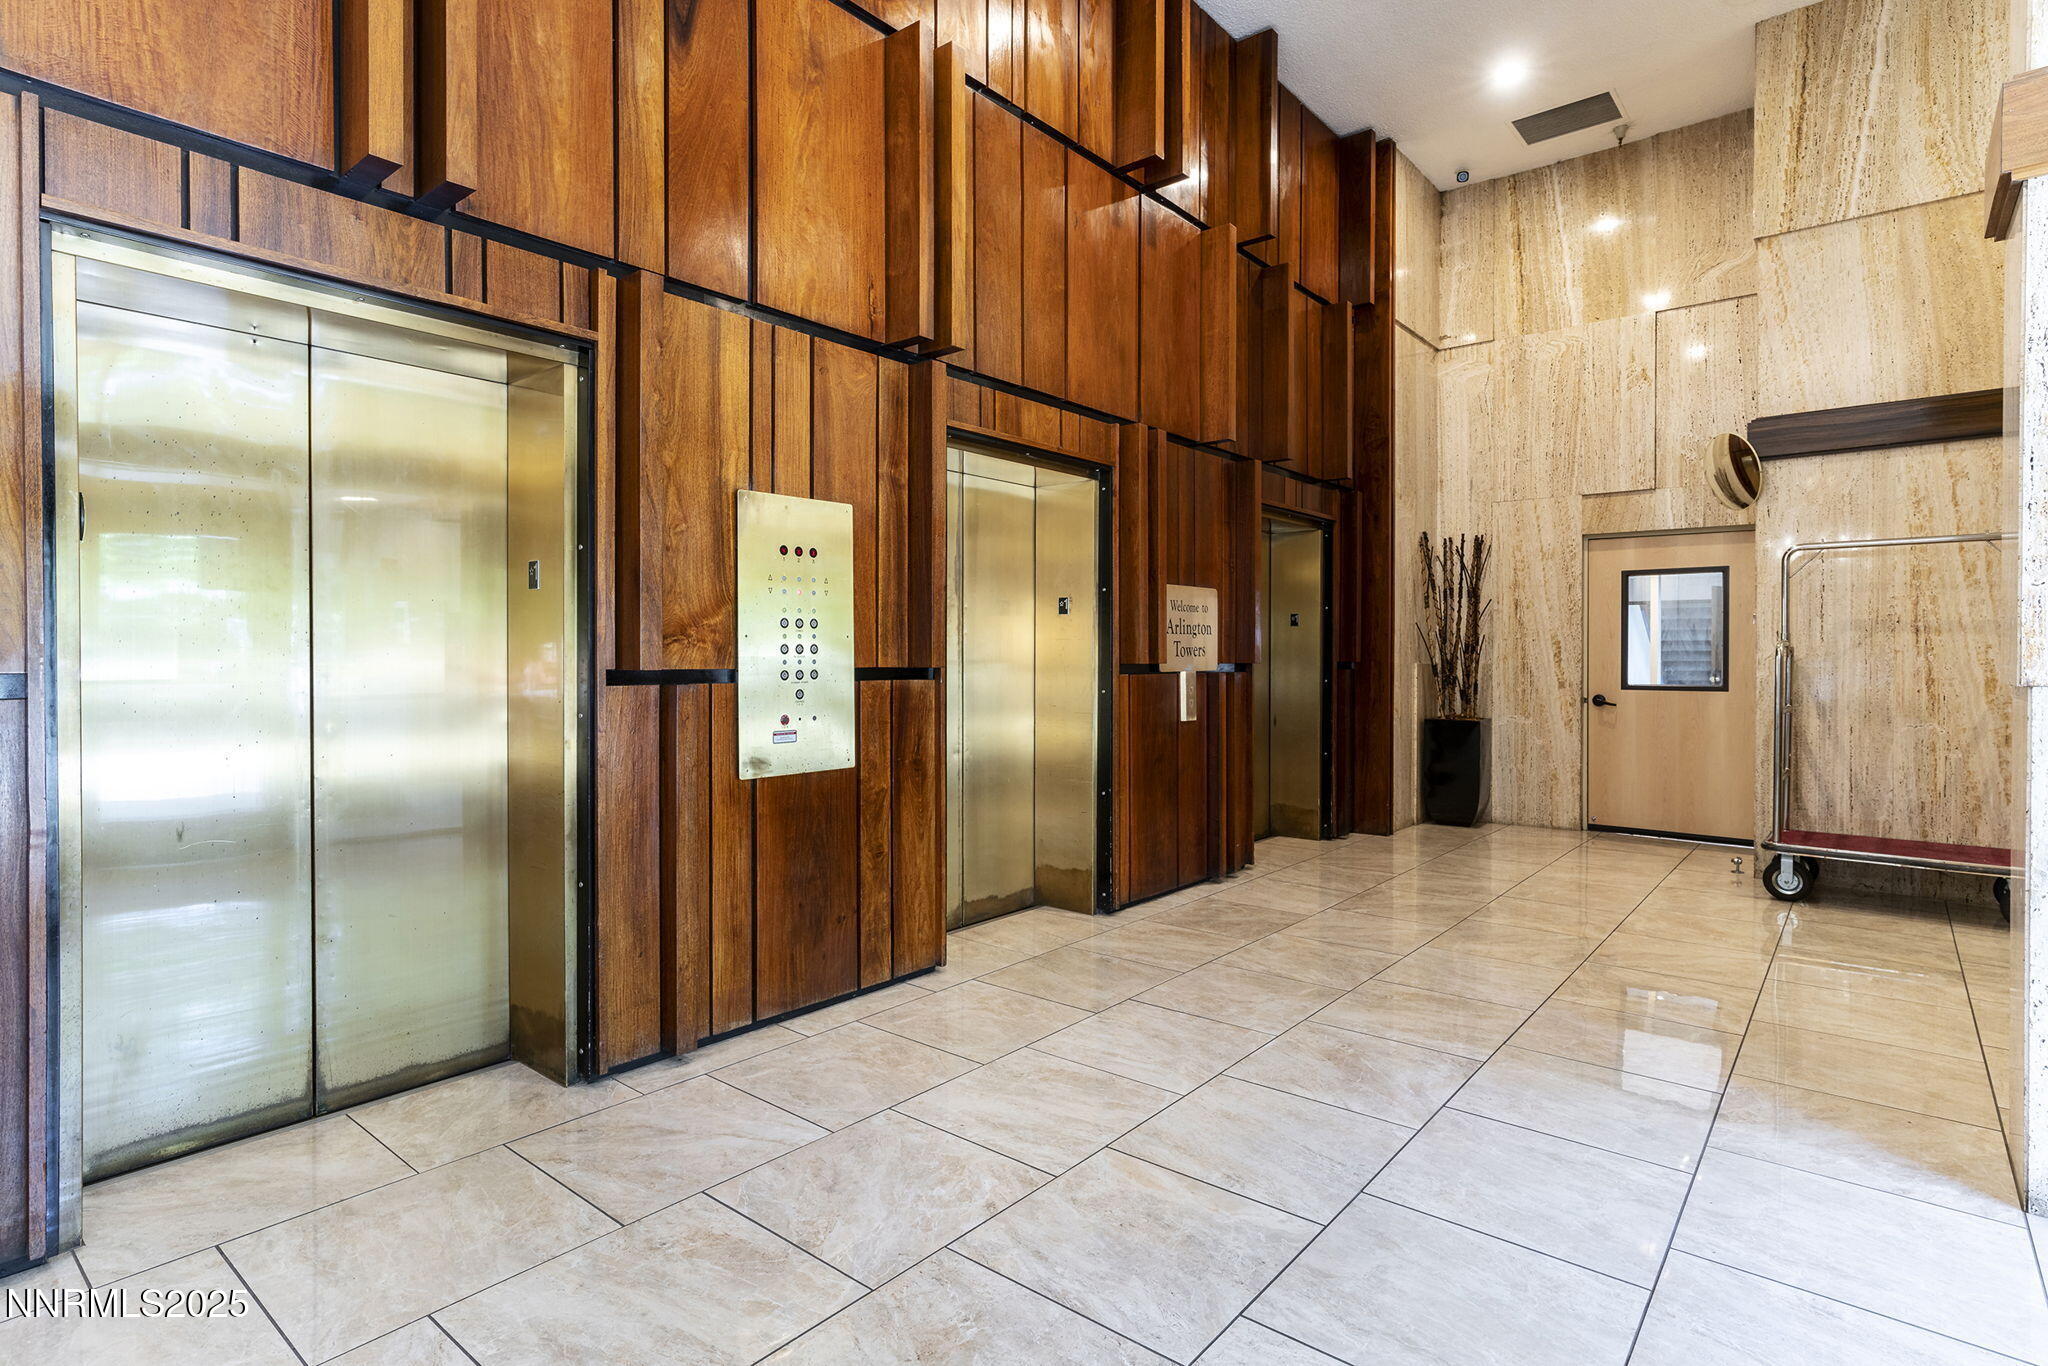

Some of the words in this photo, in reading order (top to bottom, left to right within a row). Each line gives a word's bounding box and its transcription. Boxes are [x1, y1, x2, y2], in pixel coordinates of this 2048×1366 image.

[1169, 600, 1199, 613] Welcome
[1202, 605, 1209, 613] to
[1167, 618, 1212, 638] Arlington
[1173, 640, 1206, 658] Towers
